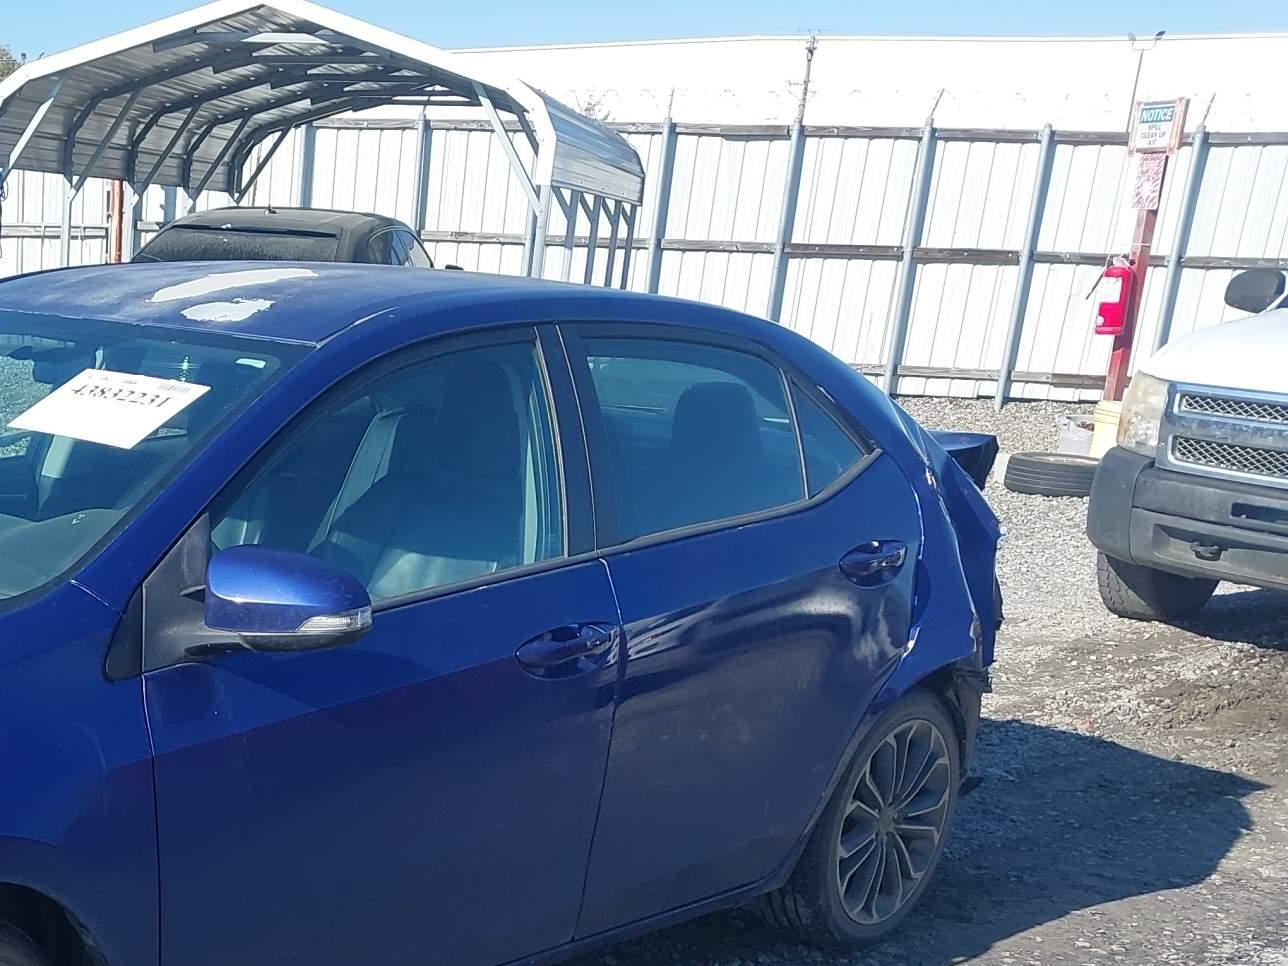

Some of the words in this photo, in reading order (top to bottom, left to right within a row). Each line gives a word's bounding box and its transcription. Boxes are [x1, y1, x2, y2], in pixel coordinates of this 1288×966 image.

[1141, 107, 1174, 122] NOTICE
[1140, 131, 1158, 139] CLEAN
[1158, 130, 1167, 138] UP
[72, 384, 172, 407] 43832231
